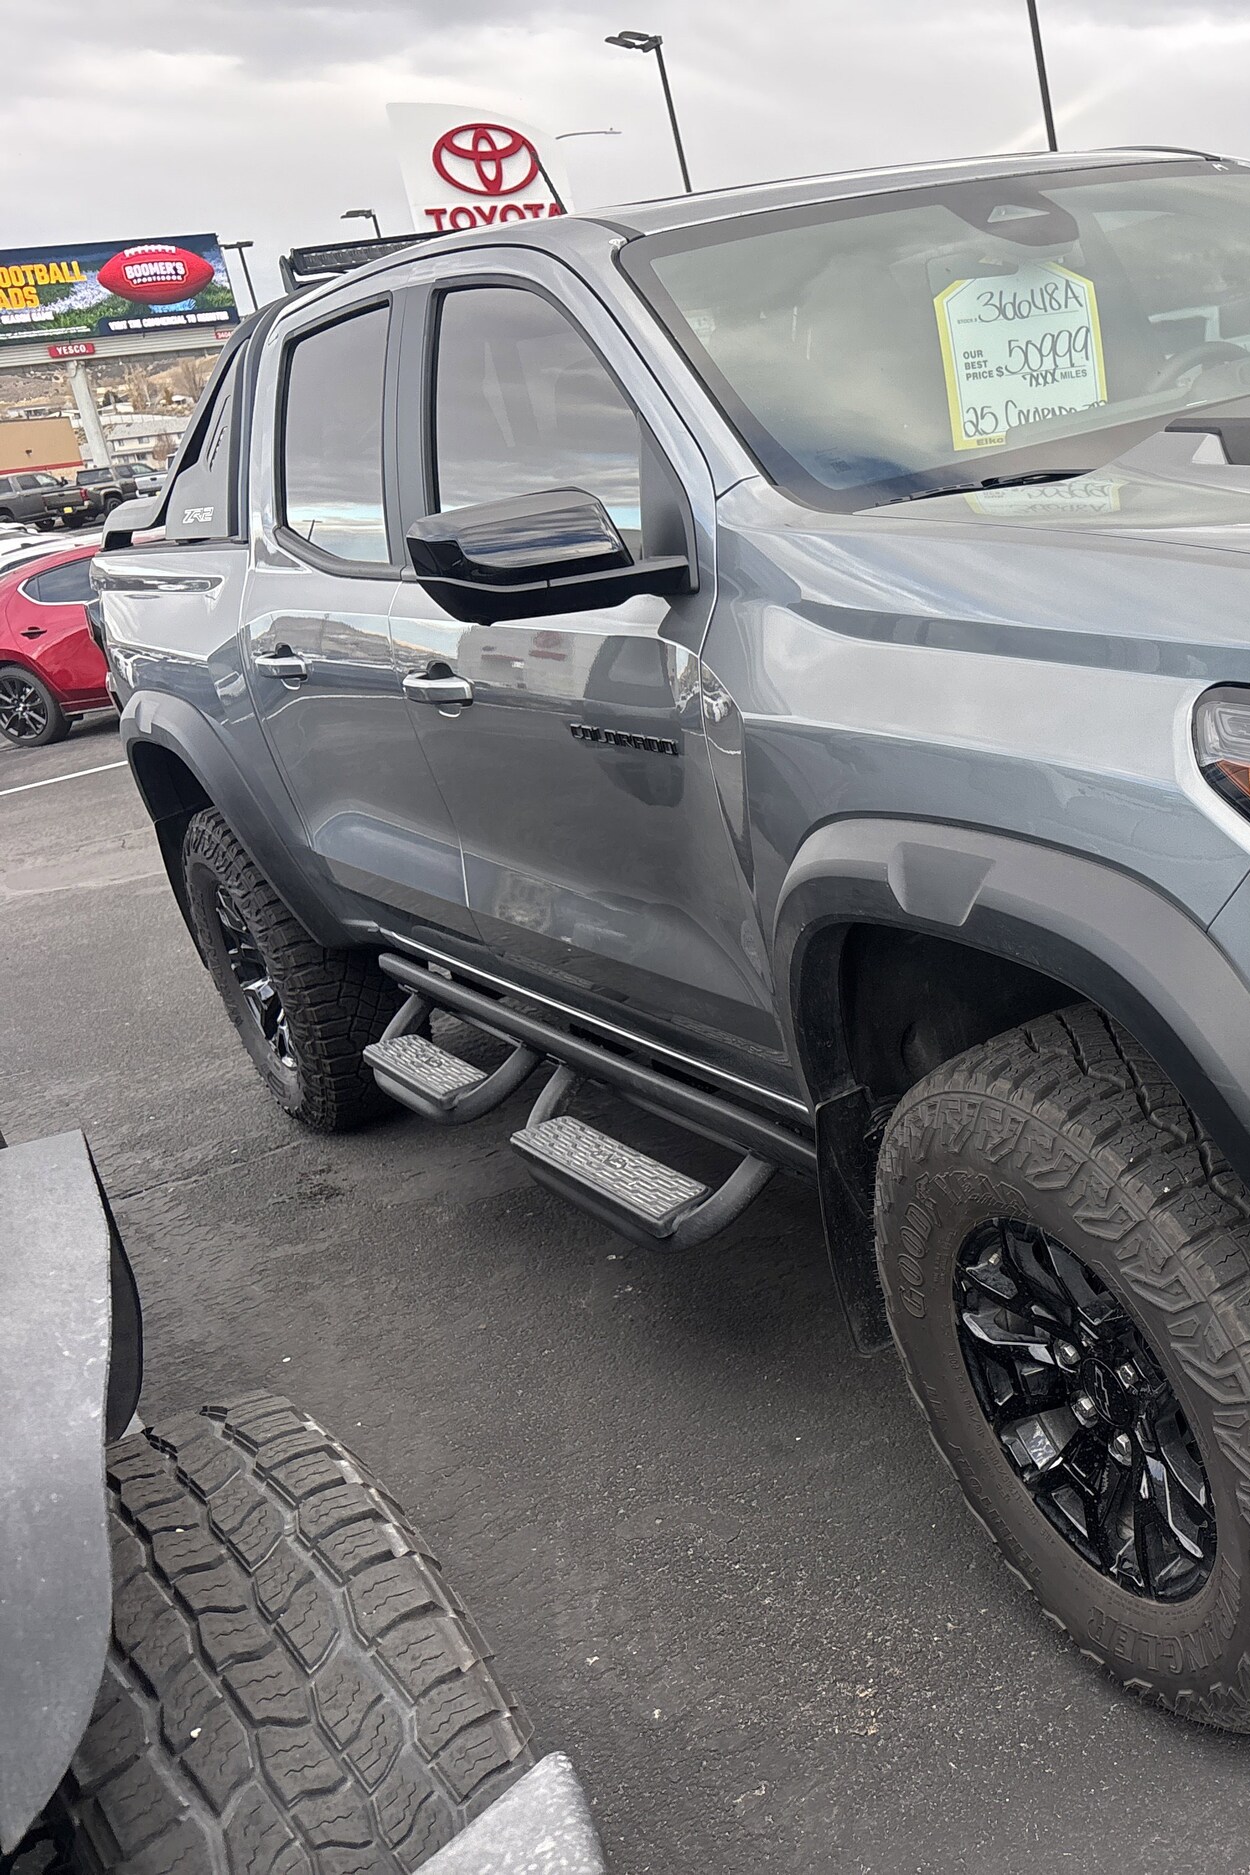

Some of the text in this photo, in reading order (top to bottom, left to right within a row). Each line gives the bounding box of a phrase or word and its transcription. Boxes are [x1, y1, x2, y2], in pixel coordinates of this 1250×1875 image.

[125, 262, 185, 279] BOOMER'S
[56, 345, 87, 355] YESCO
[963, 349, 984, 360] OUR
[964, 360, 988, 370] BEST
[966, 370, 994, 381] PRICE
[1060, 369, 1088, 380] MILES
[963, 406, 999, 438] 25
[976, 436, 1004, 446] Elko
[182, 506, 214, 524] ZR2
